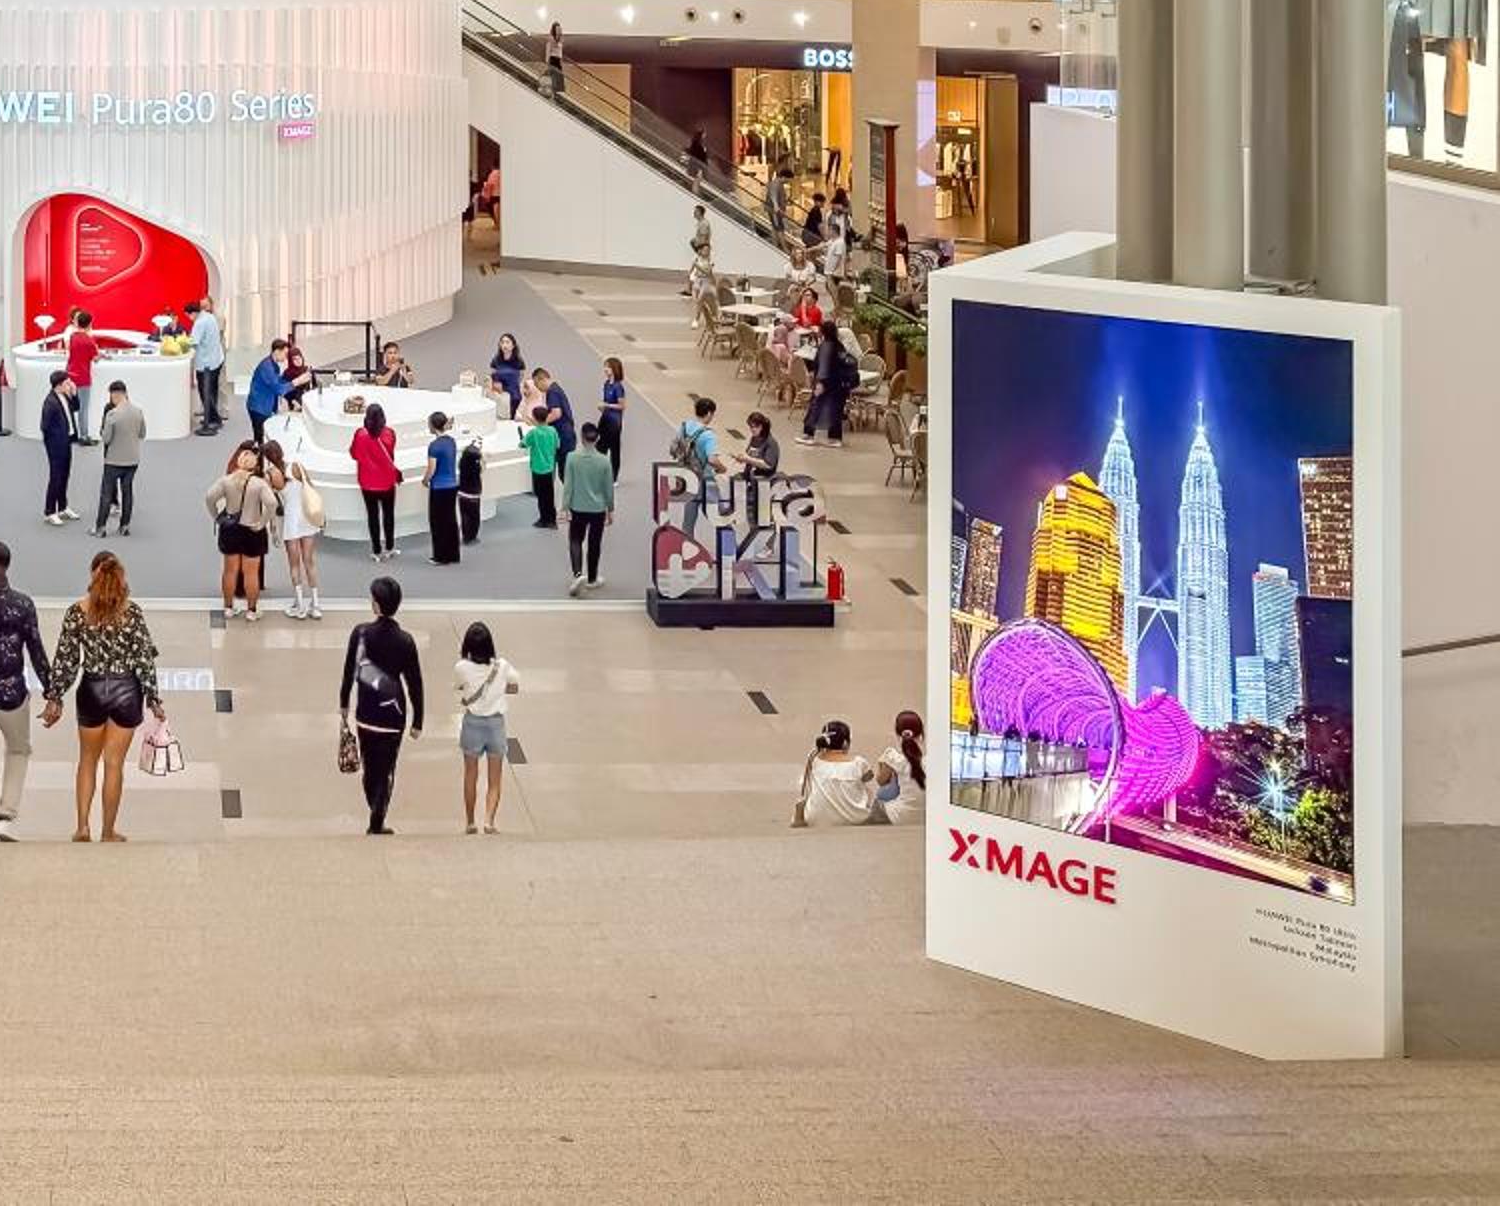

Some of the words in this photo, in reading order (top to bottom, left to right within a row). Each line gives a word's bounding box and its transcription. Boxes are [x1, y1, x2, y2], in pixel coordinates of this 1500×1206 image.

[93, 90, 216, 125] Pura80
[230, 88, 315, 122] Series
[948, 828, 1117, 905] XMAGE
